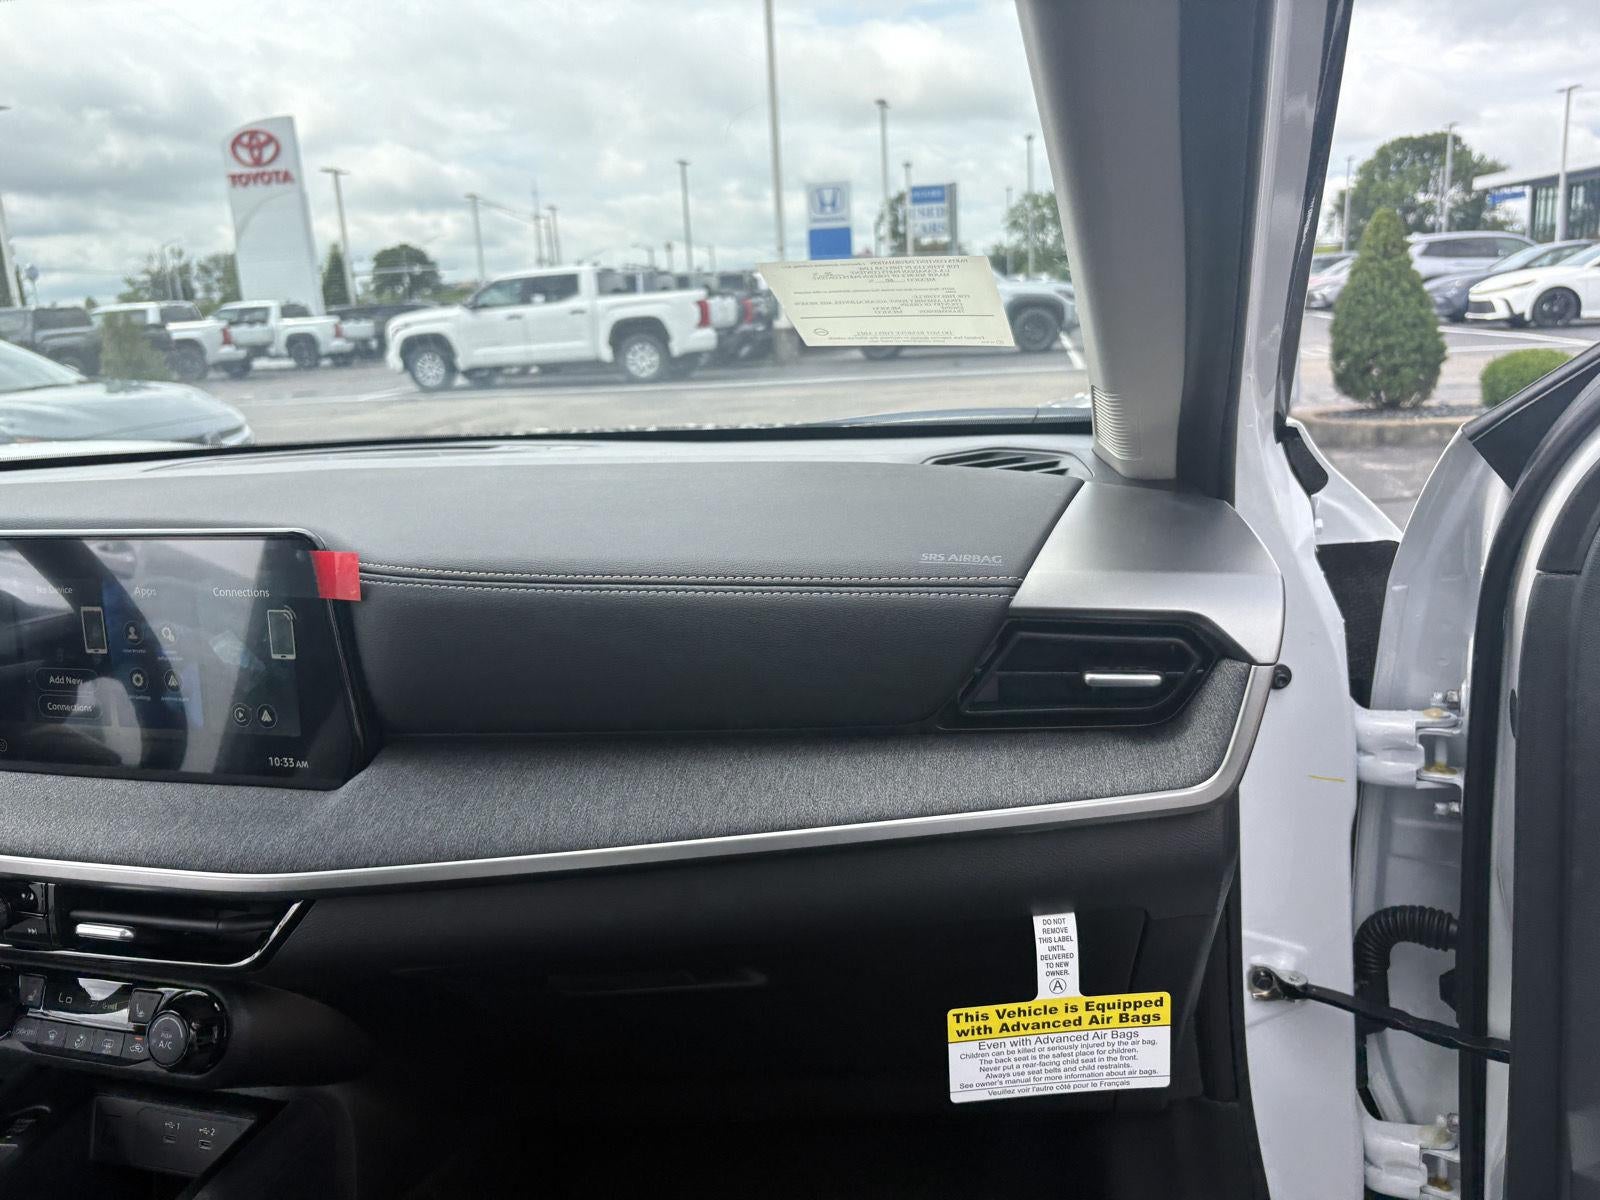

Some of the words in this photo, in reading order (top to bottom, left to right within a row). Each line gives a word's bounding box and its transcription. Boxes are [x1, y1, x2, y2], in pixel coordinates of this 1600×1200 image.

[227, 170, 295, 188] TOYOTA
[921, 553, 945, 561] SRS
[948, 554, 1002, 564] AIRBAG
[134, 586, 157, 599] Apps
[212, 586, 270, 599] Connections
[50, 676, 66, 685] Add
[67, 676, 83, 685] New
[47, 702, 94, 713] Connections
[268, 756, 295, 768] 10:33
[296, 759, 309, 769] AM
[1042, 918, 1052, 926] DO
[1053, 917, 1066, 925] NOT
[1040, 953, 1075, 961] DELIVERED
[1045, 969, 1070, 977] OWNER.
[953, 1011, 989, 1023] This
[995, 1005, 1059, 1020] Vehicle
[1064, 1003, 1079, 1014] is
[1085, 997, 1164, 1013] Equipped
[956, 1024, 993, 1037] with
[998, 1015, 1082, 1034] Advanced
[1088, 1013, 1113, 1026] Air
[1118, 1012, 1161, 1025] Bags
[158, 1040, 173, 1050] A/C
[978, 1041, 1006, 1050] Even
[1009, 1037, 1031, 1047] with
[1034, 1032, 1089, 1045] Advanced
[1092, 1031, 1108, 1041] Air
[1111, 1030, 1139, 1041] Bags
[959, 1051, 990, 1060] Children
[1017, 1046, 1036, 1054] killed
[1047, 1042, 1079, 1052] seriously
[1080, 1041, 1105, 1050] injured
[1106, 1040, 1116, 1048] by
[994, 1056, 1012, 1064] back
[1052, 1051, 1074, 1059] safest
[1075, 1050, 1095, 1058] place
[1107, 1047, 1139, 1055] children.
[979, 1065, 1001, 1073] Never
[1002, 1063, 1014, 1071] put
[1022, 1059, 1061, 1069] rear-facing
[1062, 1057, 1079, 1065] child
[1080, 1056, 1097, 1064] seat
[985, 1071, 1011, 1080] Always
[1078, 1063, 1095, 1071] child
[975, 1079, 1004, 1088] owner's
[1005, 1077, 1031, 1085] manual
[1044, 1074, 1062, 1082] more
[1064, 1071, 1104, 1080] information
[1105, 1069, 1126, 1077] about
[987, 1088, 1016, 1097] Veuillez
[1032, 1084, 1054, 1092] l'autre
[1055, 1082, 1072, 1090] côté
[1072, 1082, 1089, 1091] pour
[1099, 1079, 1130, 1088] Français
